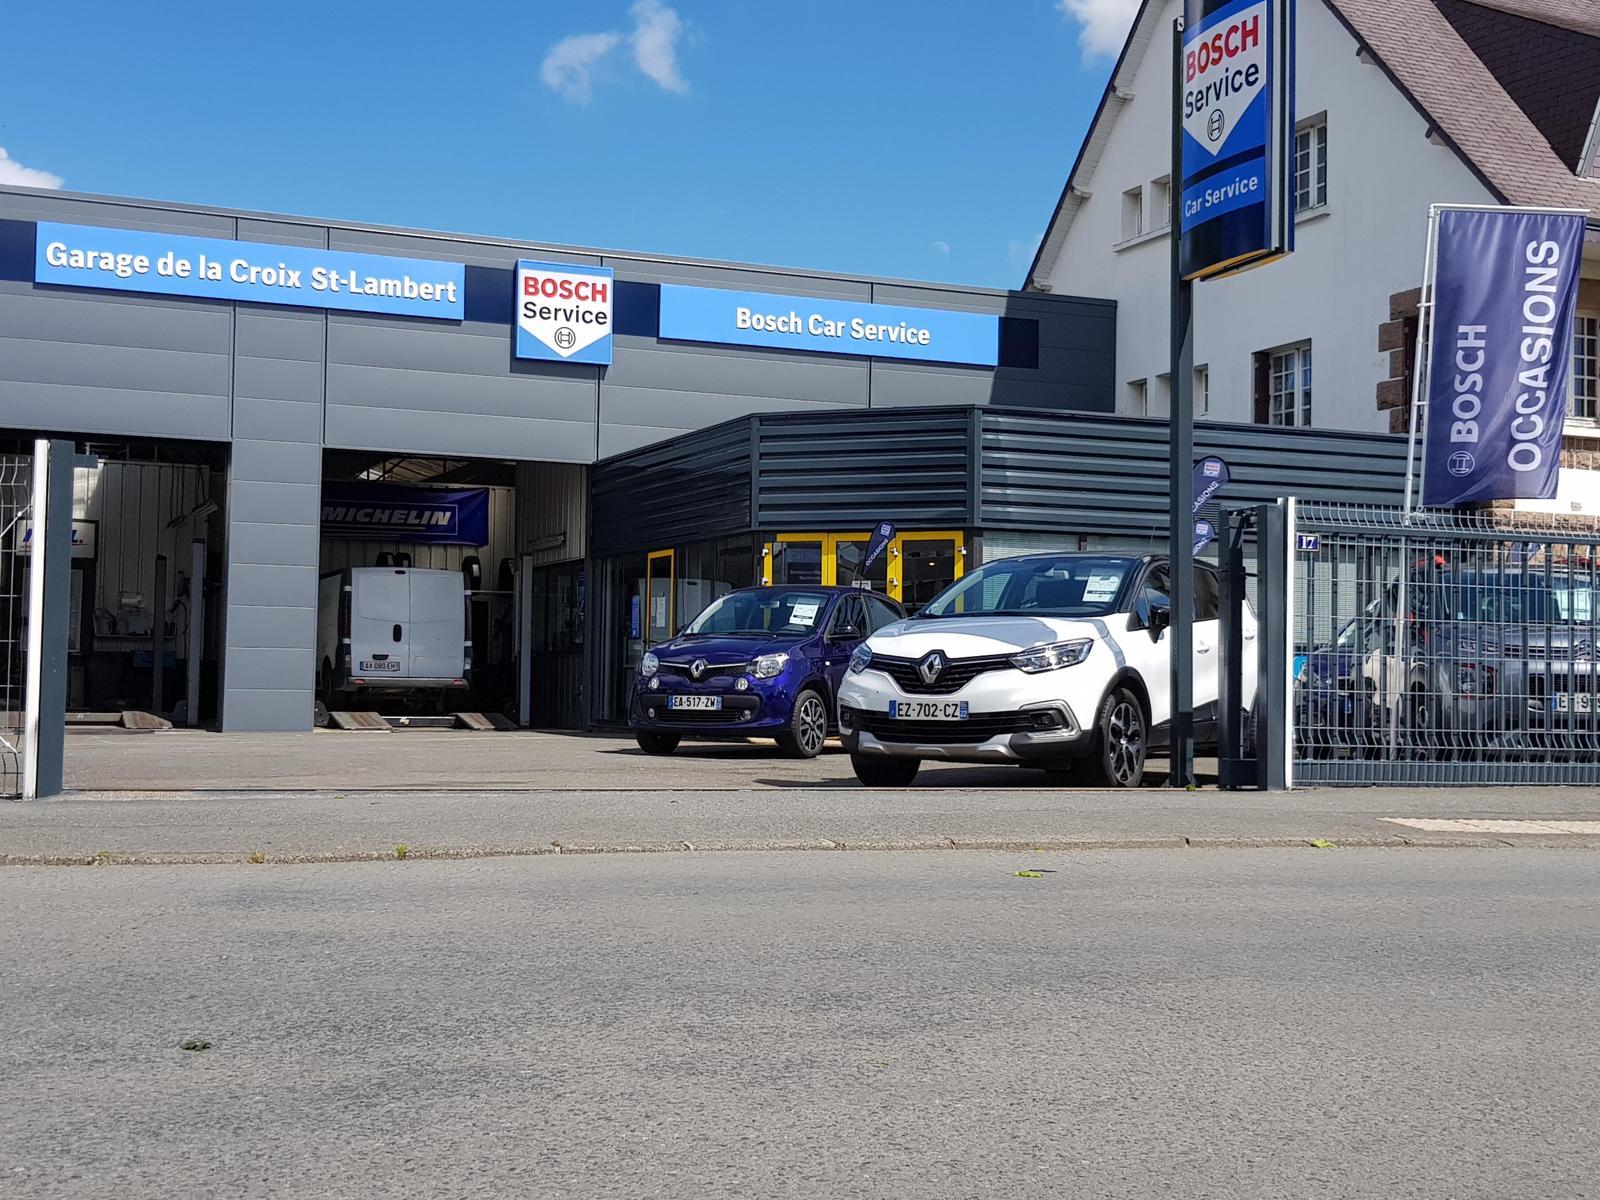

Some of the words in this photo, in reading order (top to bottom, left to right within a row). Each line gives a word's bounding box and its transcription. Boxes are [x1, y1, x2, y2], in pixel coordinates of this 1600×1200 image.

[1186, 15, 1259, 85] BOSCH
[1185, 63, 1260, 119] Service
[1185, 198, 1202, 218] Car
[1205, 176, 1258, 208] Service
[46, 242, 150, 277] Garage
[156, 251, 192, 277] de
[198, 254, 222, 280] la
[229, 258, 303, 289] Croix
[310, 266, 457, 302] St-Lambert
[524, 276, 608, 303] BOSCH
[523, 301, 608, 326] Service
[736, 306, 803, 334] Bosch
[808, 314, 846, 338] Car
[850, 317, 931, 345] Service
[1508, 240, 1560, 472] OCCASIONS
[1450, 324, 1487, 443] BOSCH
[321, 506, 451, 526] MICHELIN
[1301, 536, 1316, 549] 17
[673, 696, 716, 708] EA-517-ZW
[897, 702, 959, 718] EZ-702-CZ
